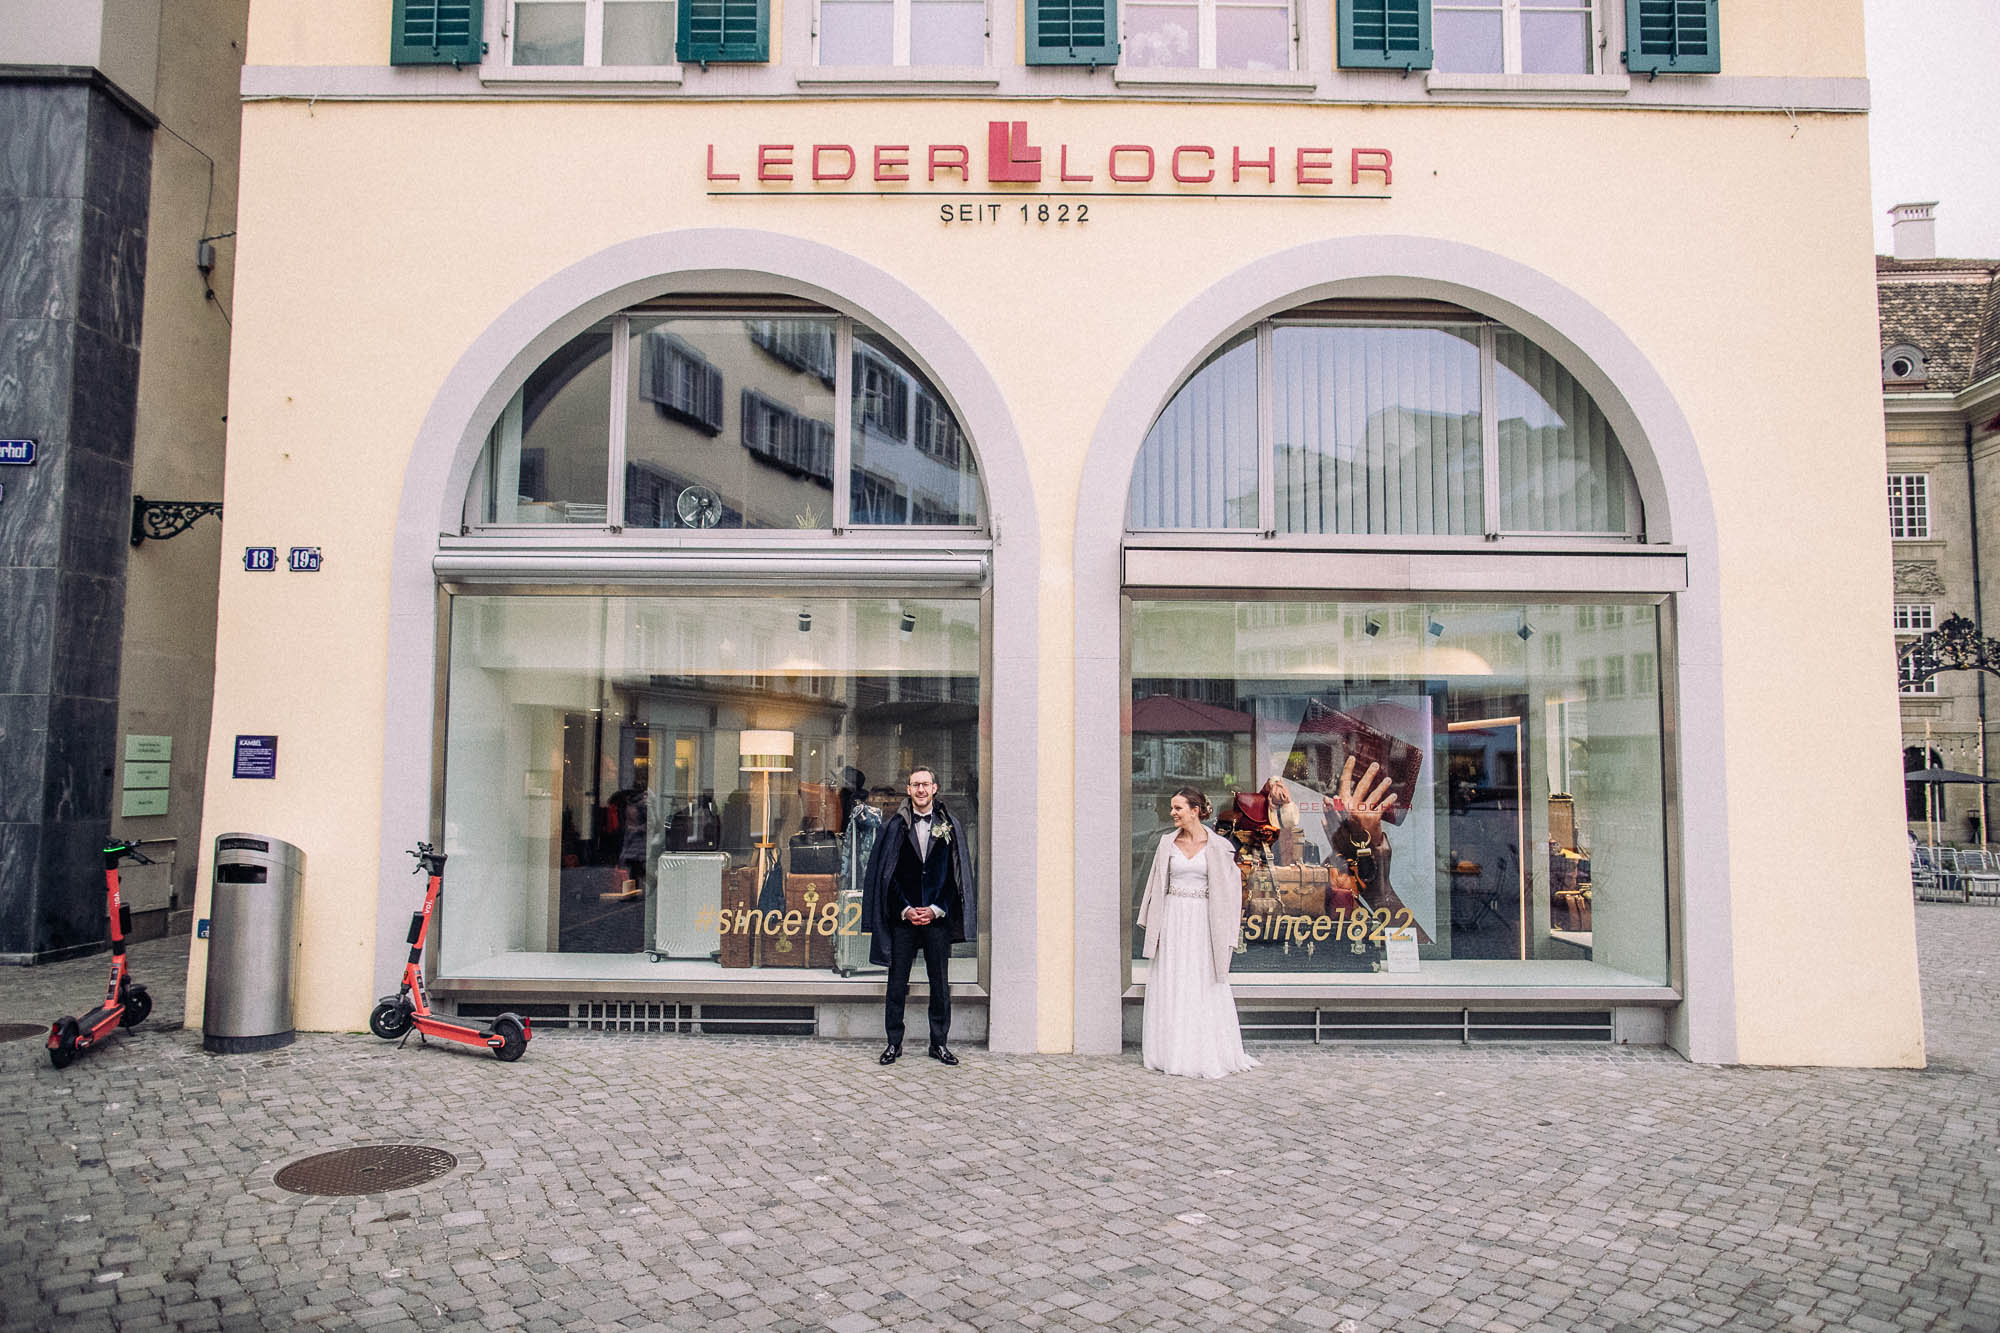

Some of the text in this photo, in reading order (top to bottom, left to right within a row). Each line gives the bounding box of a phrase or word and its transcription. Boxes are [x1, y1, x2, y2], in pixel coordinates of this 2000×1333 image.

[707, 144, 969, 182] LEDER
[1061, 144, 1392, 185] LOCHER
[940, 204, 1089, 222] SEIT 1822
[252, 550, 269, 568] 18
[293, 550, 317, 568] 19a
[693, 901, 872, 936] #since182
[1240, 907, 1413, 941] since1822
